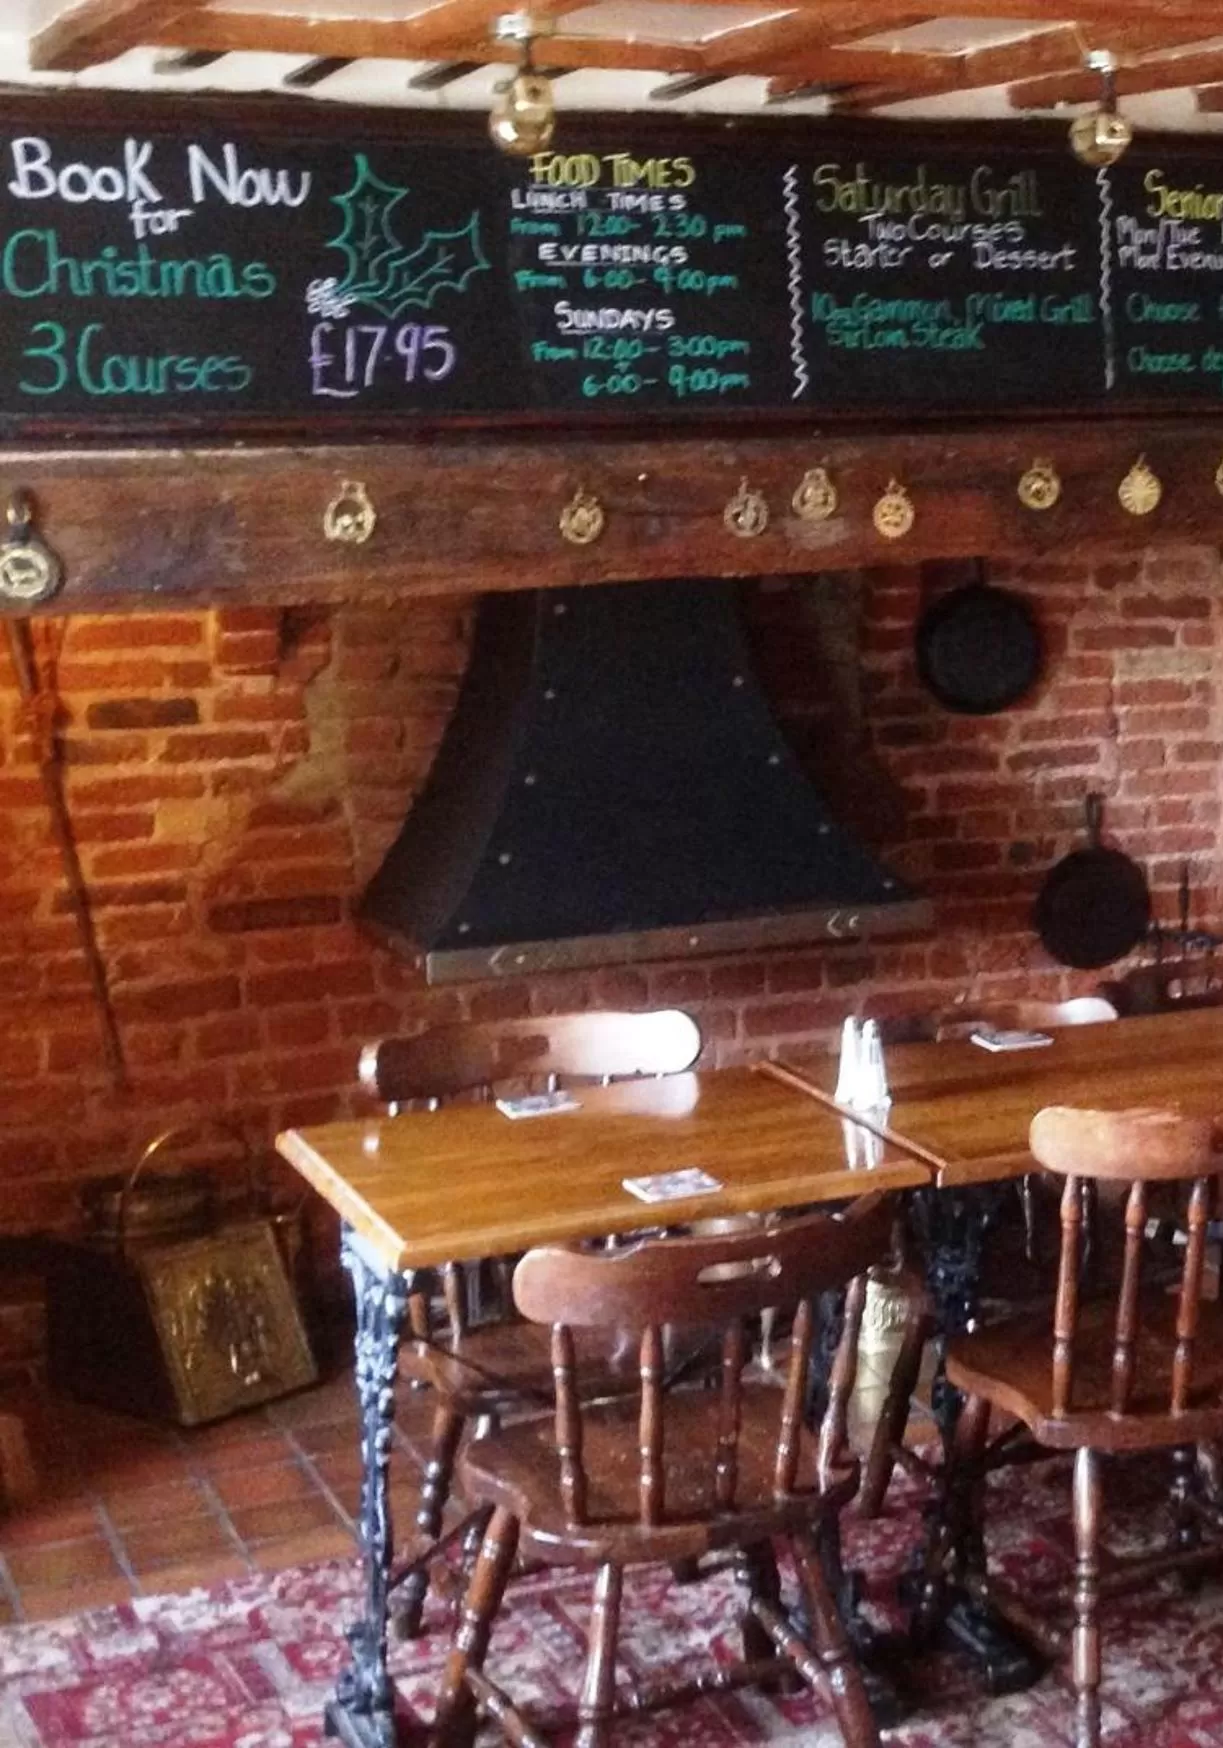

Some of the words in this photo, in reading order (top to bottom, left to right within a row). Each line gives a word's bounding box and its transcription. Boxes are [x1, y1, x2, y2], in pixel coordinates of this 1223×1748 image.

[529, 150, 602, 188] FOOD
[813, 162, 967, 221] Saturday
[970, 165, 1045, 218] Grill
[129, 199, 197, 240] for
[2, 228, 278, 300] Christmas
[538, 242, 690, 266] EVENINGS
[823, 238, 915, 270] Starter
[972, 240, 1078, 272] Dessert
[553, 300, 677, 332] SUNDAYS
[1039, 292, 1097, 323] Grill
[18, 320, 67, 396] 3
[76, 322, 253, 397] Courses
